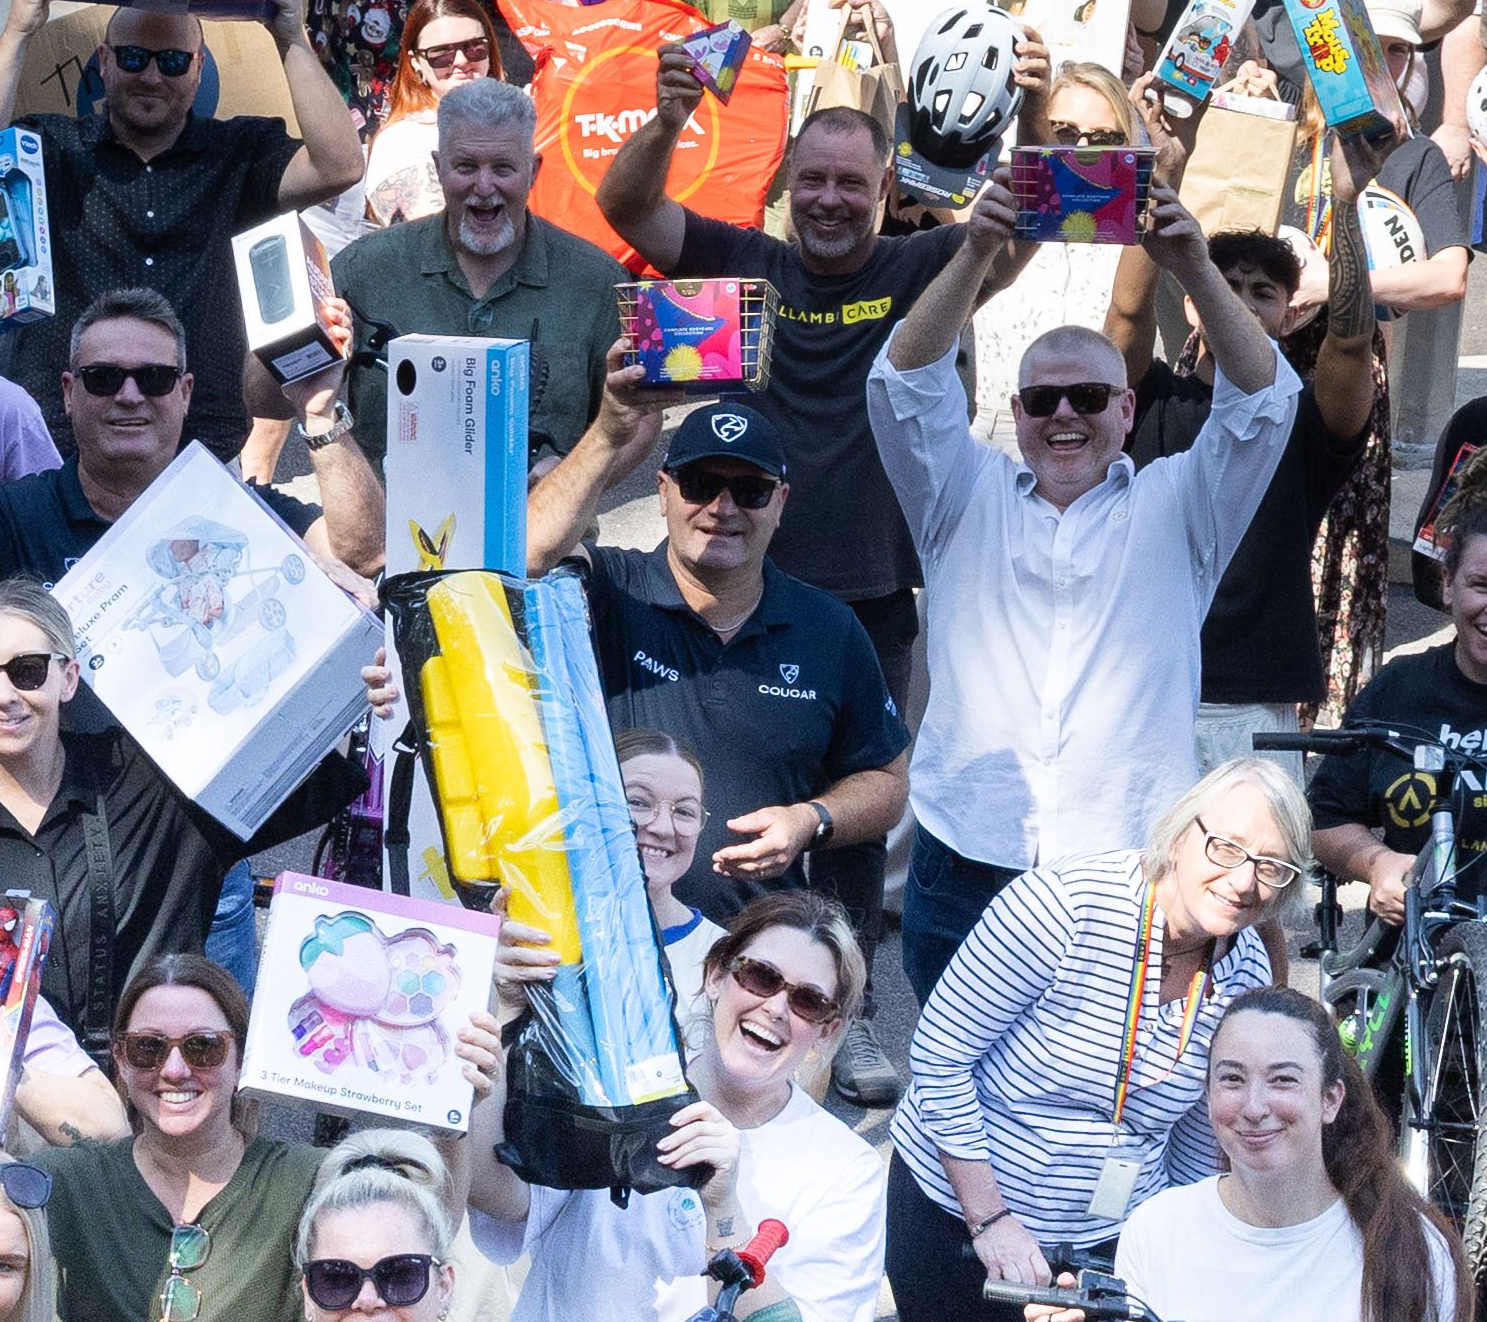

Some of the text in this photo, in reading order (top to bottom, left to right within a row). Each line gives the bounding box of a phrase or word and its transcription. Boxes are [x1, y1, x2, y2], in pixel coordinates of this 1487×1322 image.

[1307, 20, 1338, 73] Trap
[1318, 8, 1352, 74] Mouse
[20, 139, 37, 153] vtech
[583, 148, 601, 160] Big
[779, 303, 889, 324] LLAMBI CARE
[489, 360, 500, 396] anko
[465, 357, 477, 455] Big Foam Glider
[99, 584, 129, 613] Pram
[75, 635, 93, 654] Set
[633, 650, 680, 683] PAWS
[759, 683, 817, 701] COUGAR
[93, 818, 107, 916] ANXIETY
[293, 880, 329, 897] anko
[260, 1070, 423, 1112] 3 Tier Makeup Strawberry Set
